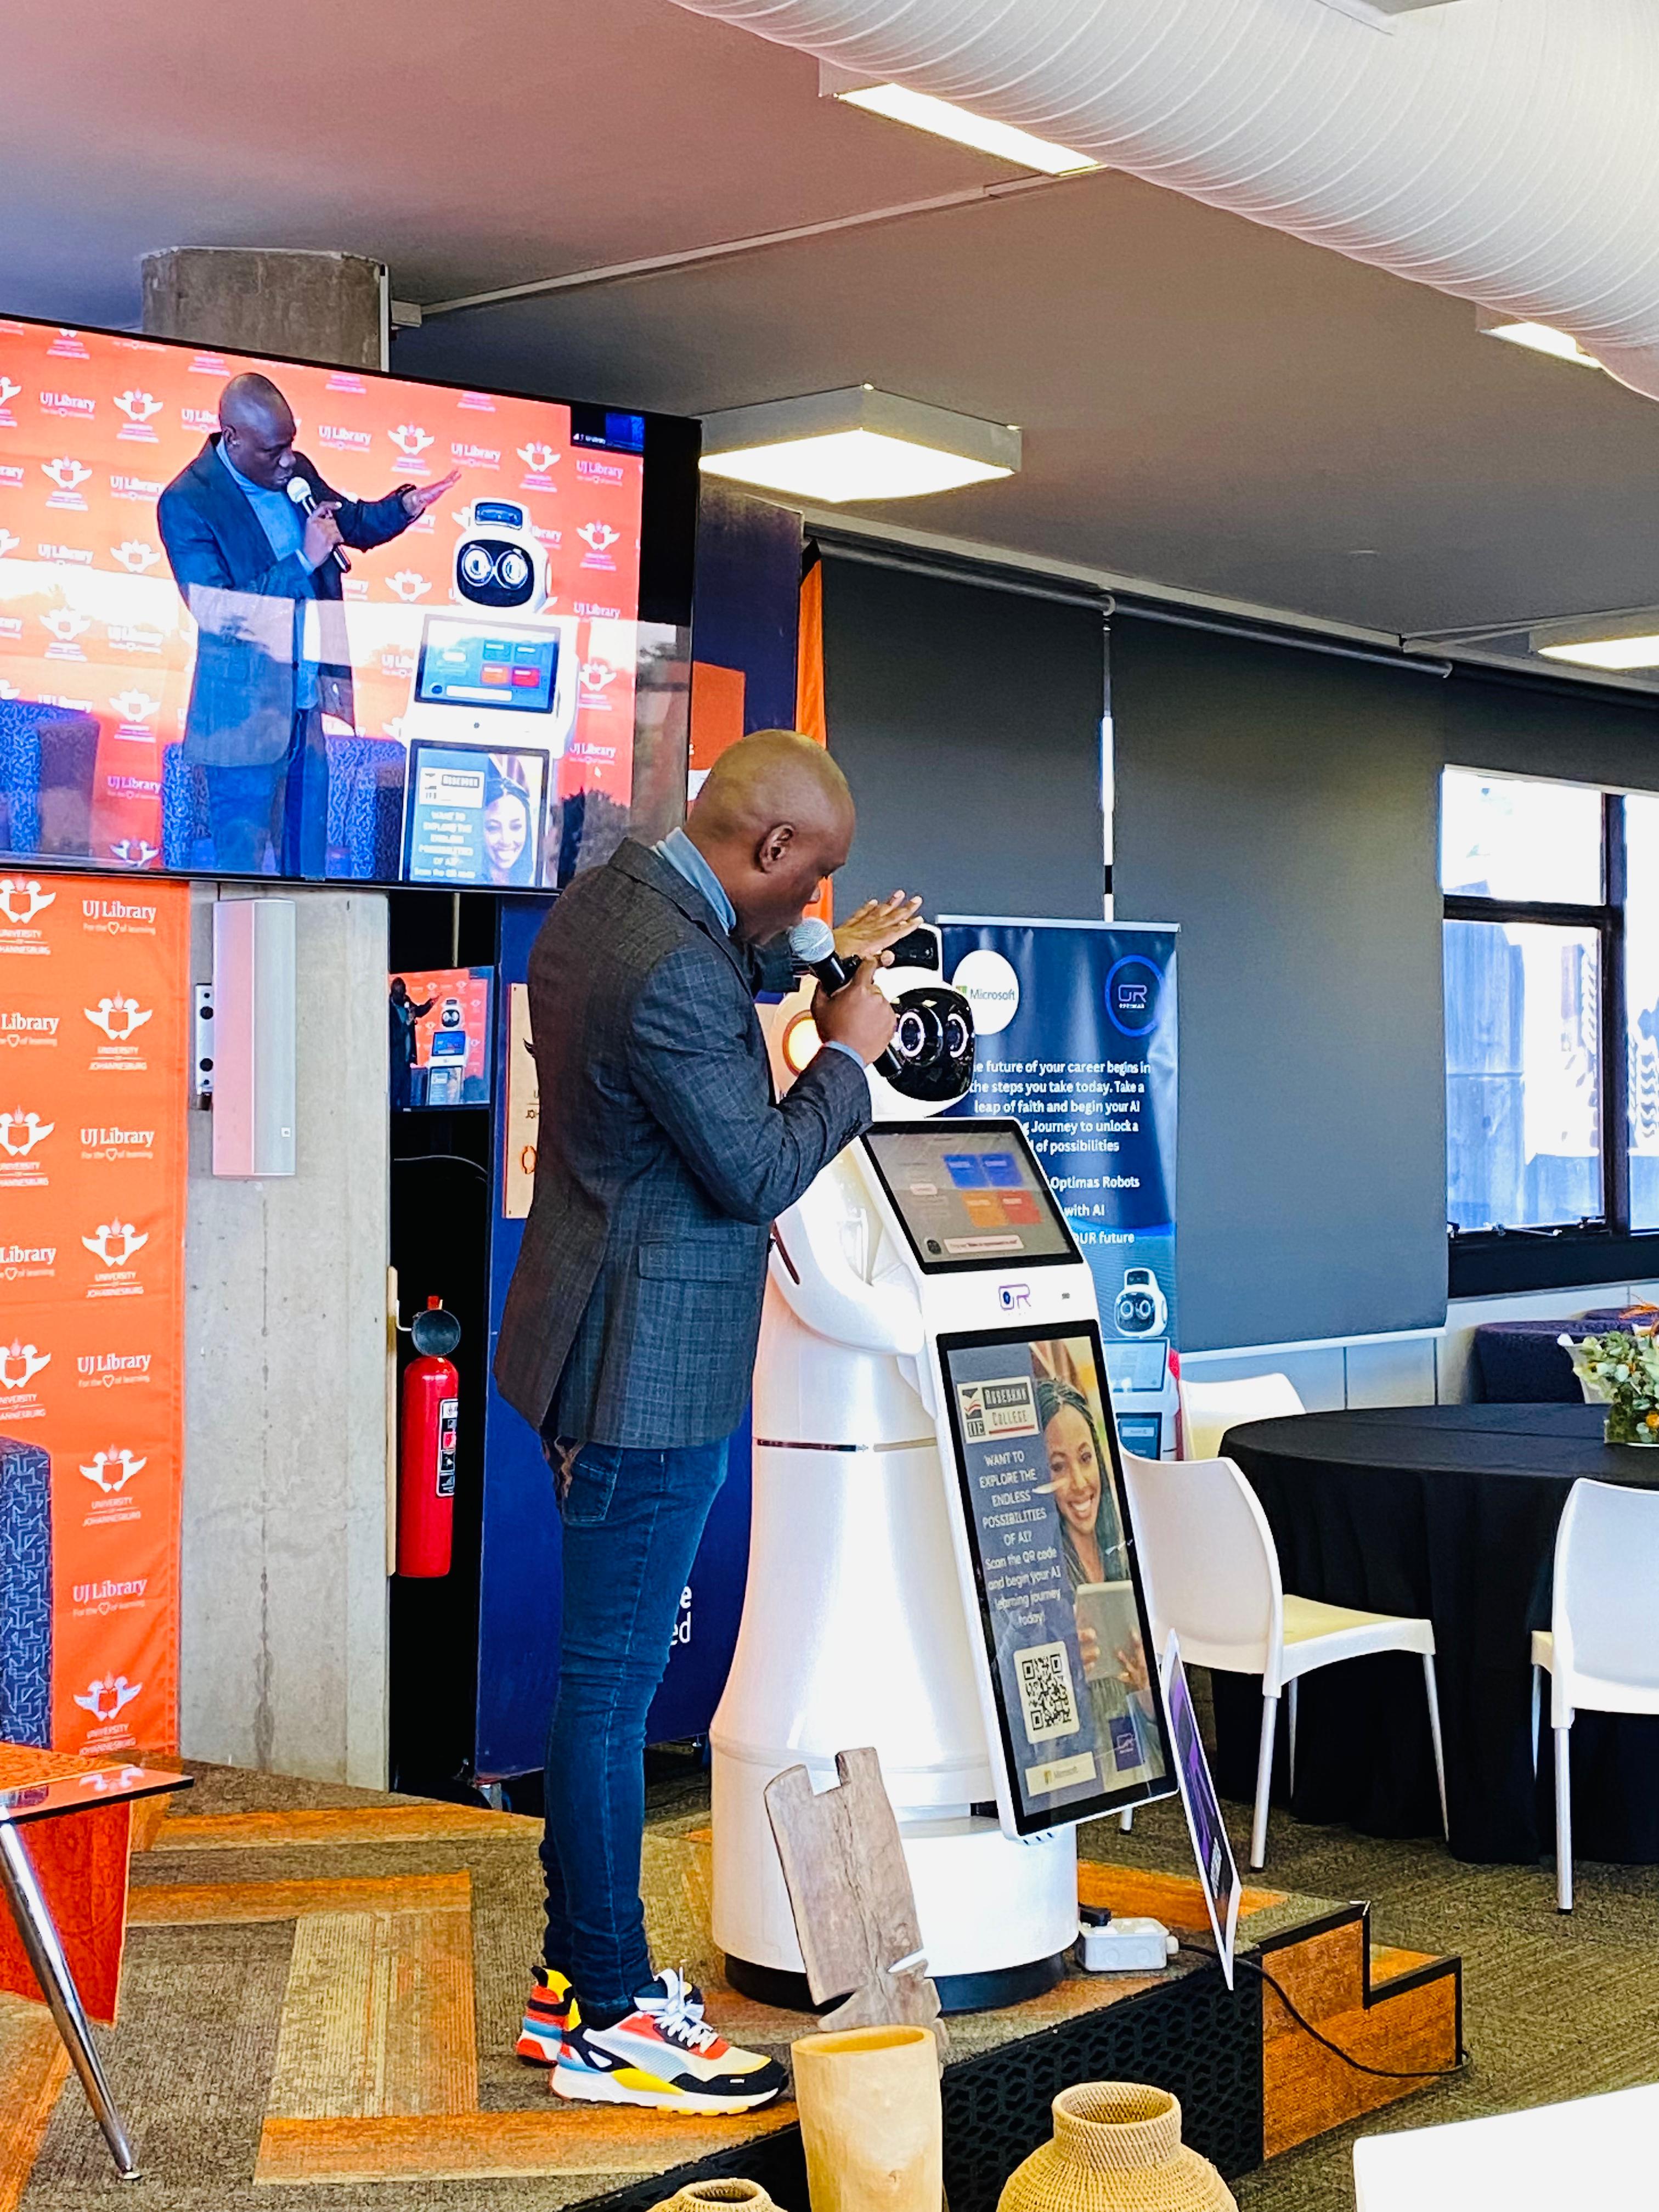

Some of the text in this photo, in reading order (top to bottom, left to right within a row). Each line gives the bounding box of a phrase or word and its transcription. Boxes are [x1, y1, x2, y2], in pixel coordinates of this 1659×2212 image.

[40, 392, 95, 413] UJ Library
[318, 426, 371, 445] UJ Library
[451, 443, 501, 462] UJ Library
[576, 460, 623, 479] UJ Library
[586, 605, 620, 619] Library
[582, 743, 616, 758] Library
[108, 776, 161, 794] UJ Library
[82, 900, 156, 923] UJ Library
[969, 988, 1015, 1001] Microsoft
[1, 1013, 59, 1035] Library
[986, 1061, 1023, 1073] future
[1025, 1060, 1038, 1073] of
[1039, 1063, 1065, 1076] your
[1068, 1063, 1105, 1073] career
[1107, 1061, 1138, 1076] begins
[1140, 1062, 1150, 1074] in
[992, 1081, 1024, 1095] steps
[1025, 1083, 1047, 1096] you
[1049, 1080, 1074, 1093] take
[1076, 1080, 1113, 1096] today.
[1114, 1081, 1137, 1093] Take
[1138, 1084, 1145, 1093] a
[974, 1100, 1141, 1115] leap of faith and begin your AI
[1031, 1121, 1077, 1135] Journey
[1080, 1122, 1093, 1132] to
[1096, 1120, 1131, 1132] unlock
[1132, 1122, 1139, 1132] a
[81, 1127, 154, 1147] UJ Library
[1036, 1139, 1049, 1153] of
[1049, 1140, 1119, 1155] possibilities
[1051, 1175, 1140, 1192] Optimas Robots
[1063, 1203, 1105, 1217] with AI
[1099, 1231, 1135, 1244] future
[0, 1245, 56, 1265] Library
[77, 1353, 151, 1375] UJ Library
[984, 1451, 1025, 1466] WANT TO
[979, 1468, 1037, 1488] EXPLORE THE
[991, 1489, 1031, 1507] ENDLESS
[1003, 1532, 1015, 1546] OF
[985, 1547, 1057, 1570] Scan the QR code
[988, 1576, 1005, 1590] and
[1051, 1566, 1061, 1579] AI
[72, 1579, 148, 1604] UJ Library
